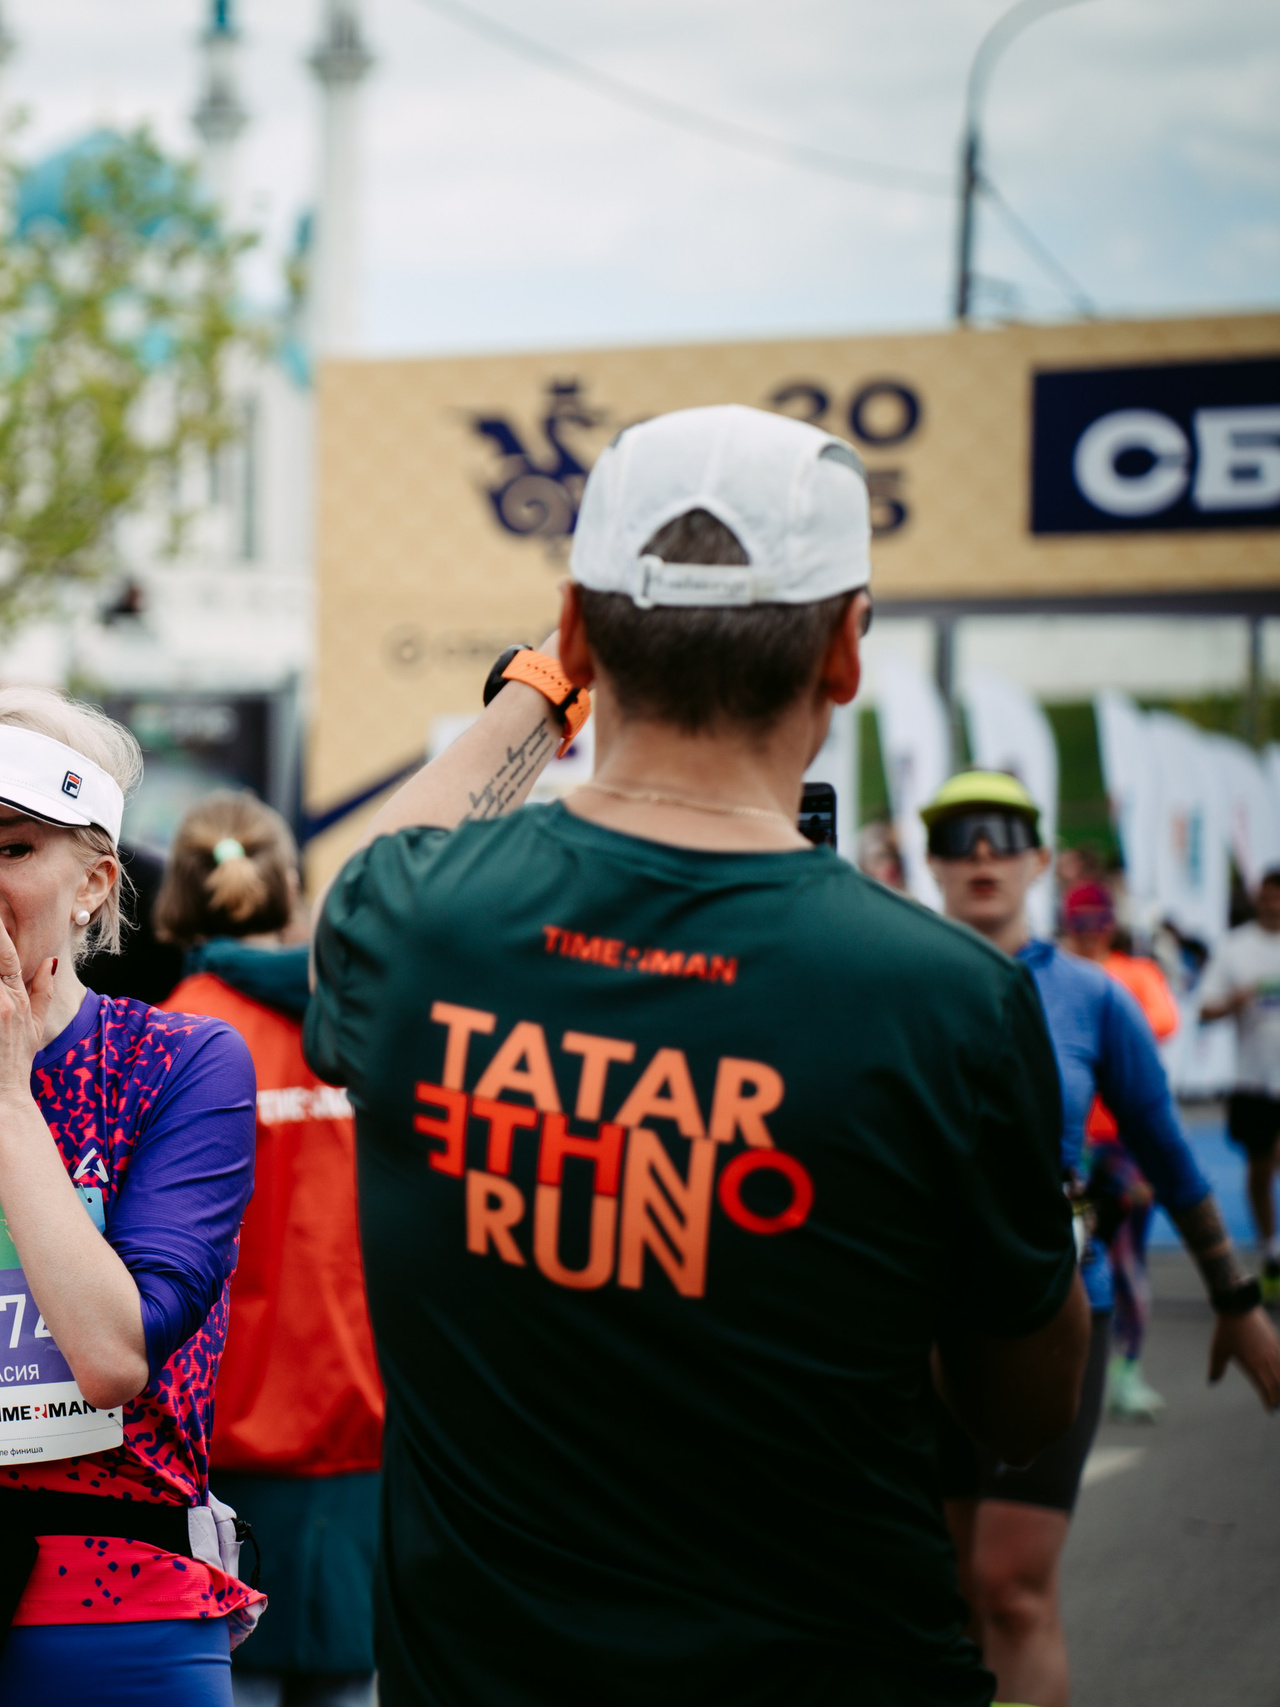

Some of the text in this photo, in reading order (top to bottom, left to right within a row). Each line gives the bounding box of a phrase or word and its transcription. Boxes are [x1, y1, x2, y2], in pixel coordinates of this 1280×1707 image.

[430, 1000, 784, 1149] TATAR
[466, 1126, 718, 1298] RUN
[10, 1446, 44, 1457] финиша
